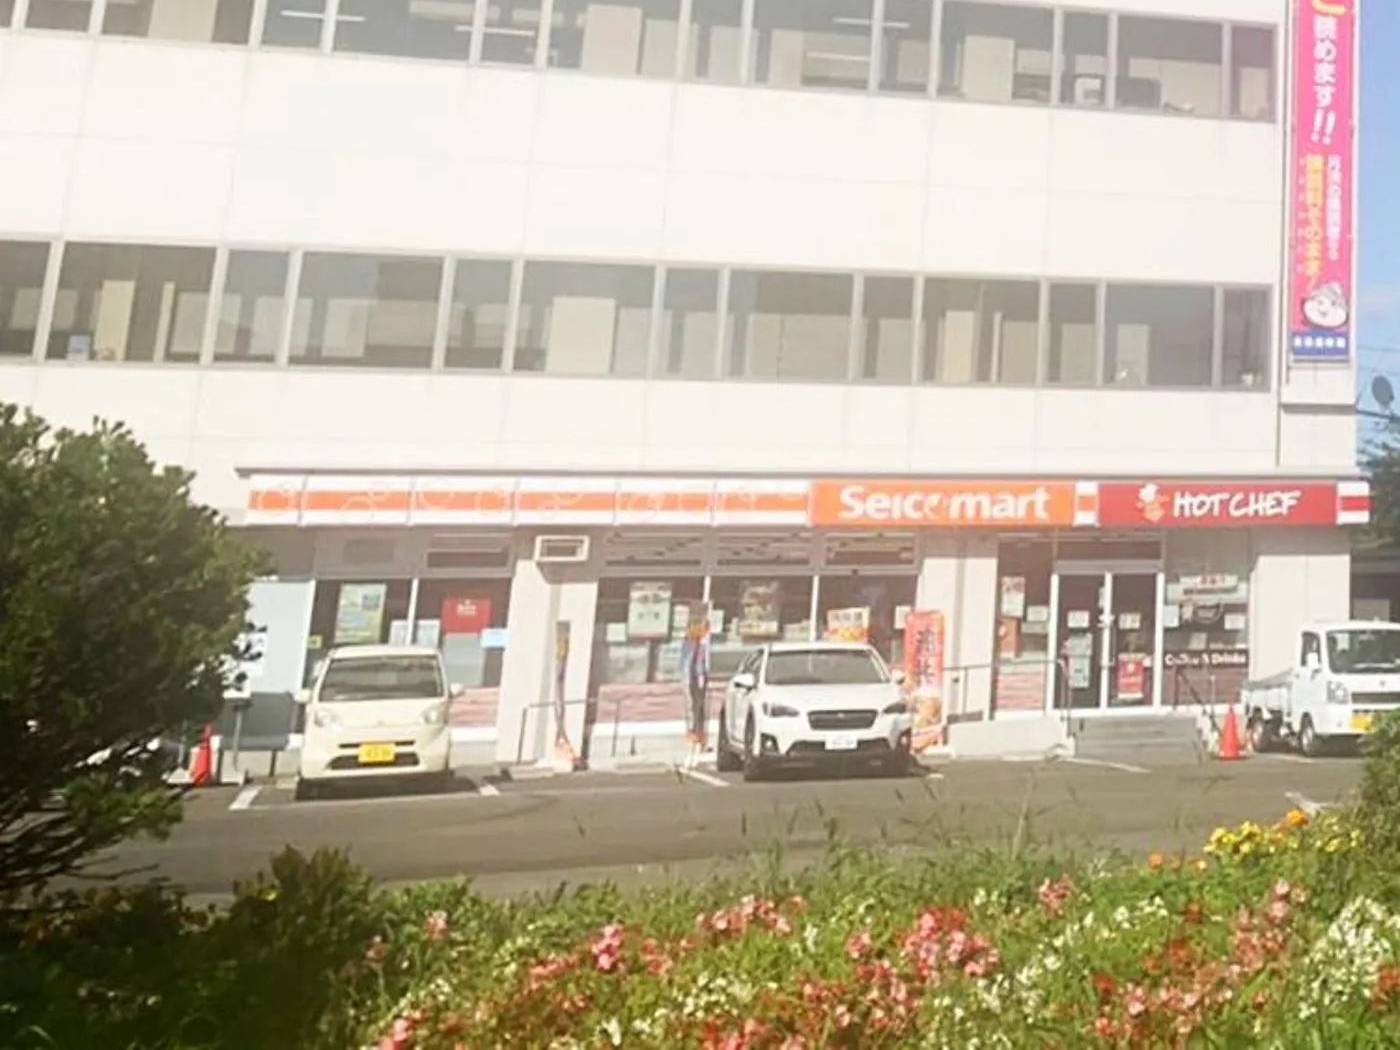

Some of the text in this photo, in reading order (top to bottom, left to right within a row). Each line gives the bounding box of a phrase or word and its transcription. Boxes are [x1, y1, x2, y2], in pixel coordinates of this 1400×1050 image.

[838, 484, 1049, 520] Seicomart
[1172, 490, 1301, 518] HOT CHEF
